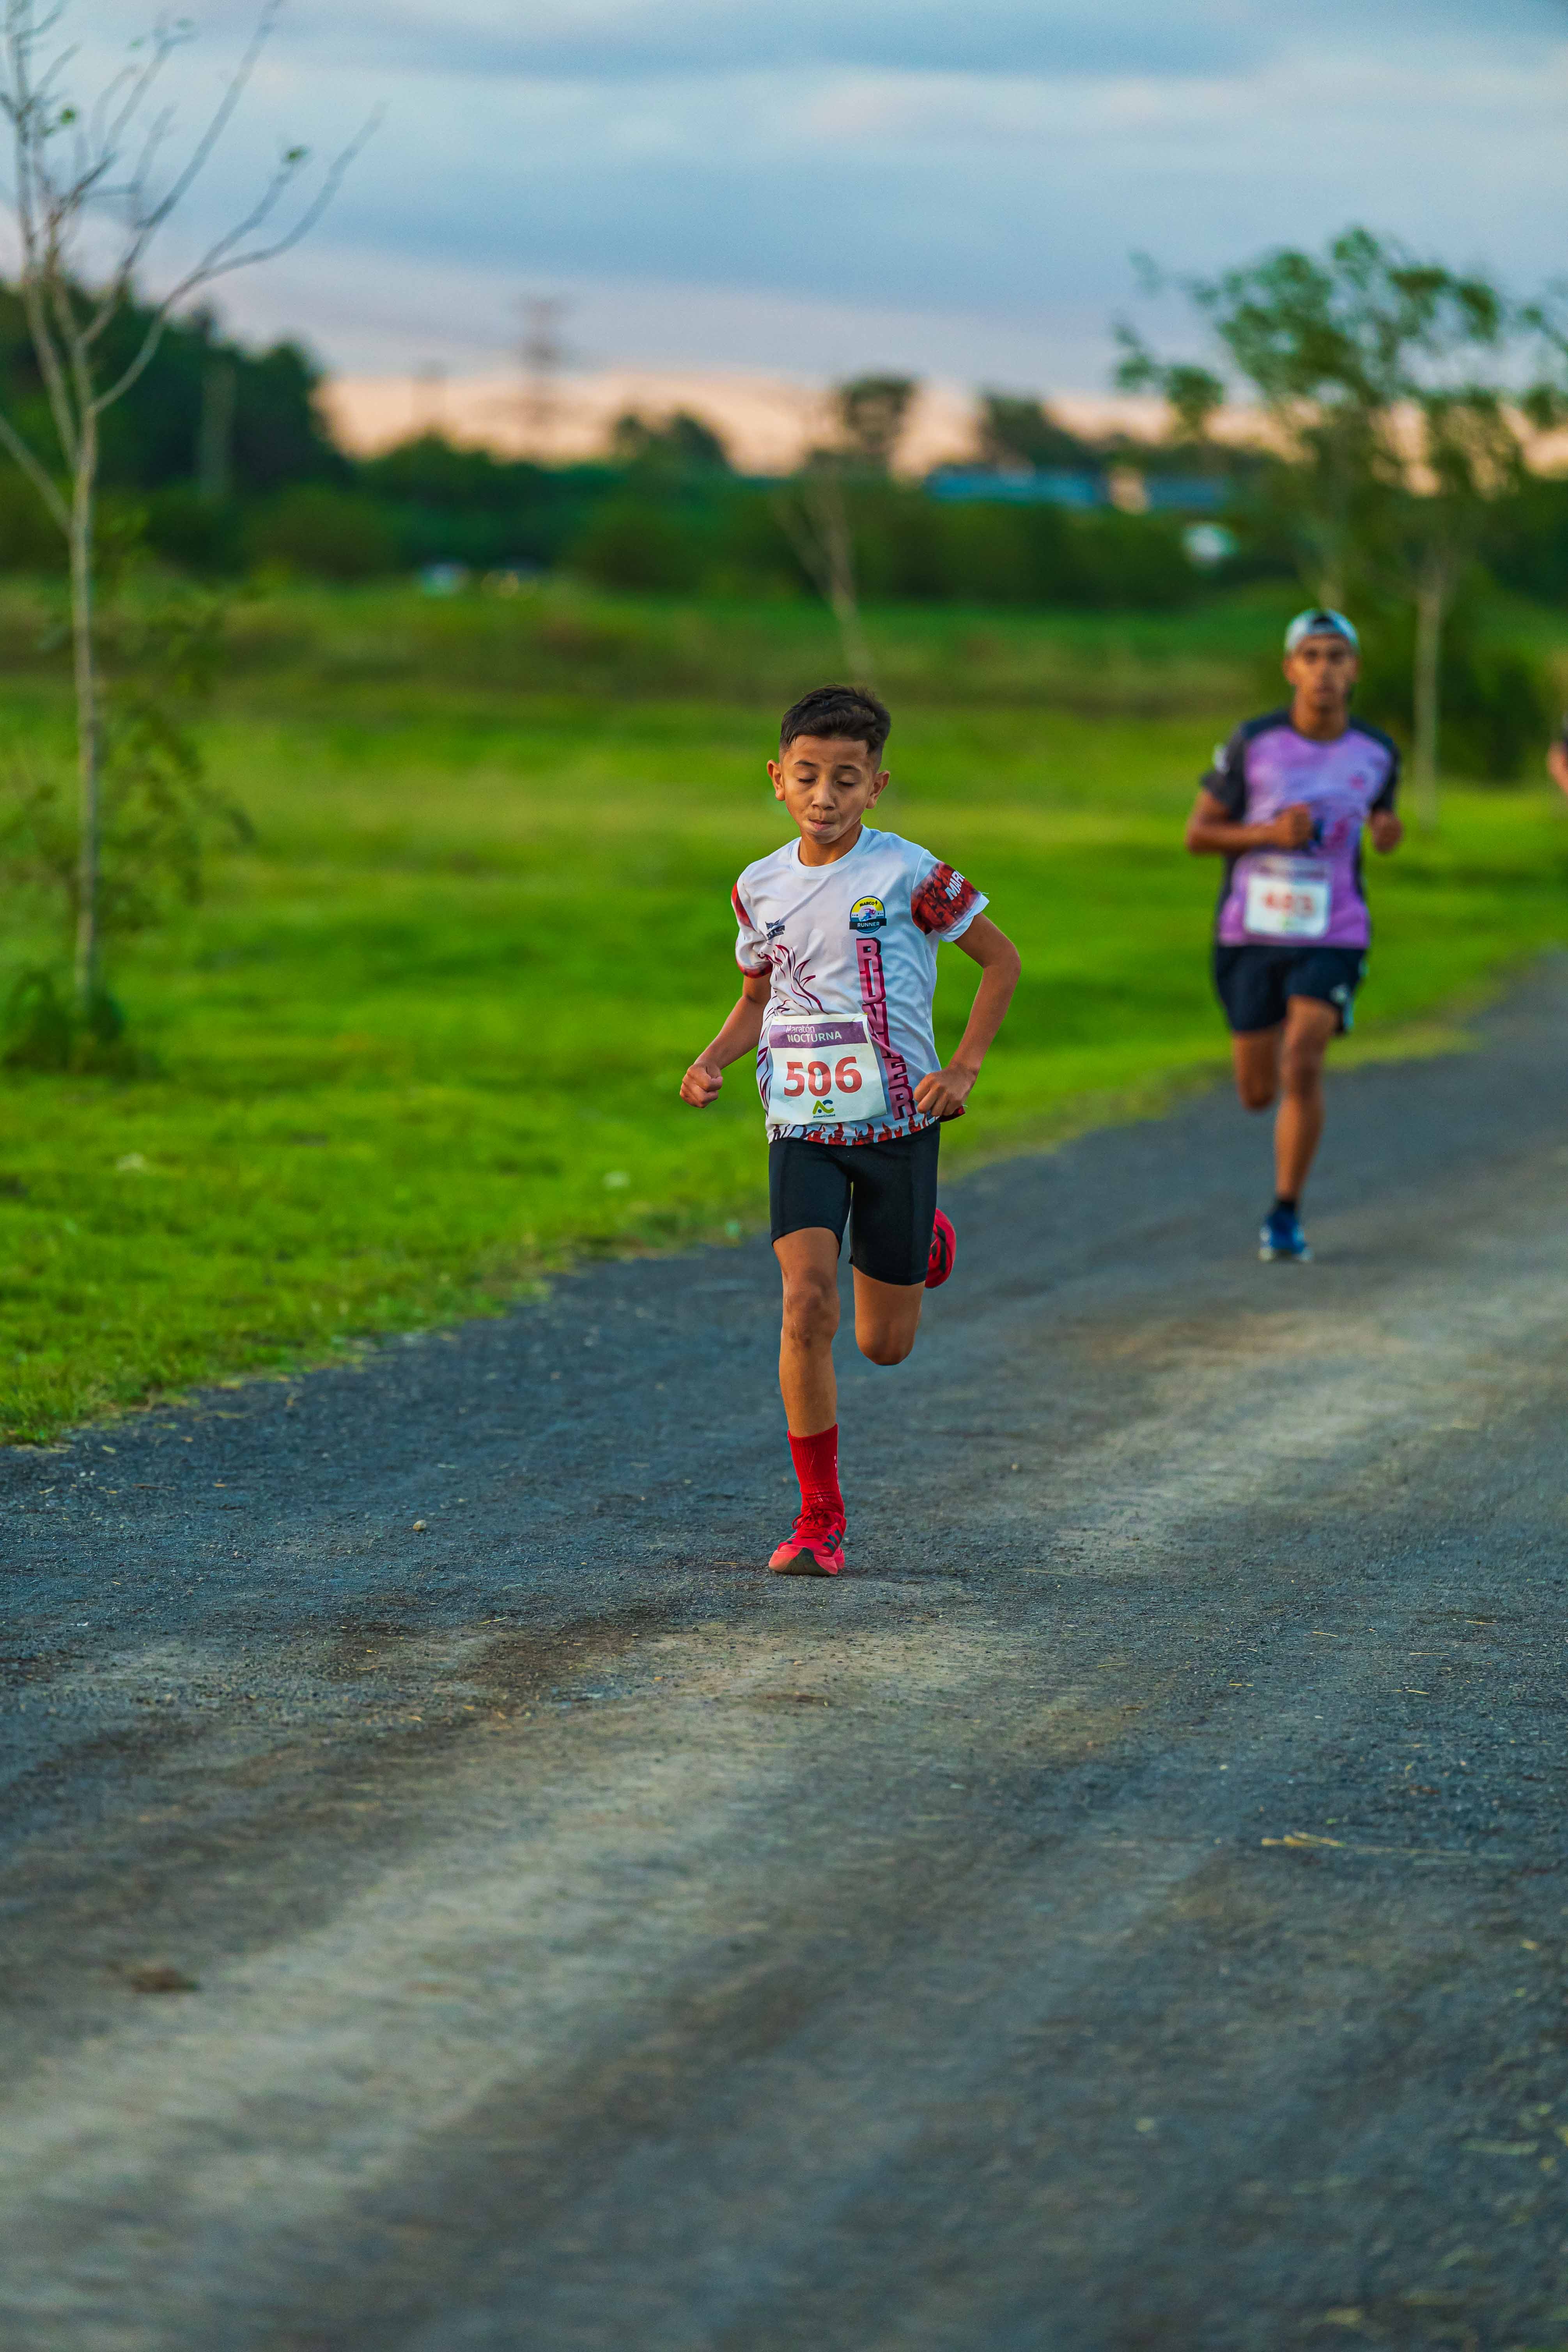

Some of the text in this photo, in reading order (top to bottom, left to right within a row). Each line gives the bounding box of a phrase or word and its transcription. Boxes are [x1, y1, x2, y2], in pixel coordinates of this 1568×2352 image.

[944, 870, 965, 900] MAR
[786, 1024, 815, 1033] Maratón
[787, 1031, 842, 1043] NOCTURNA
[784, 1056, 862, 1097] 506
